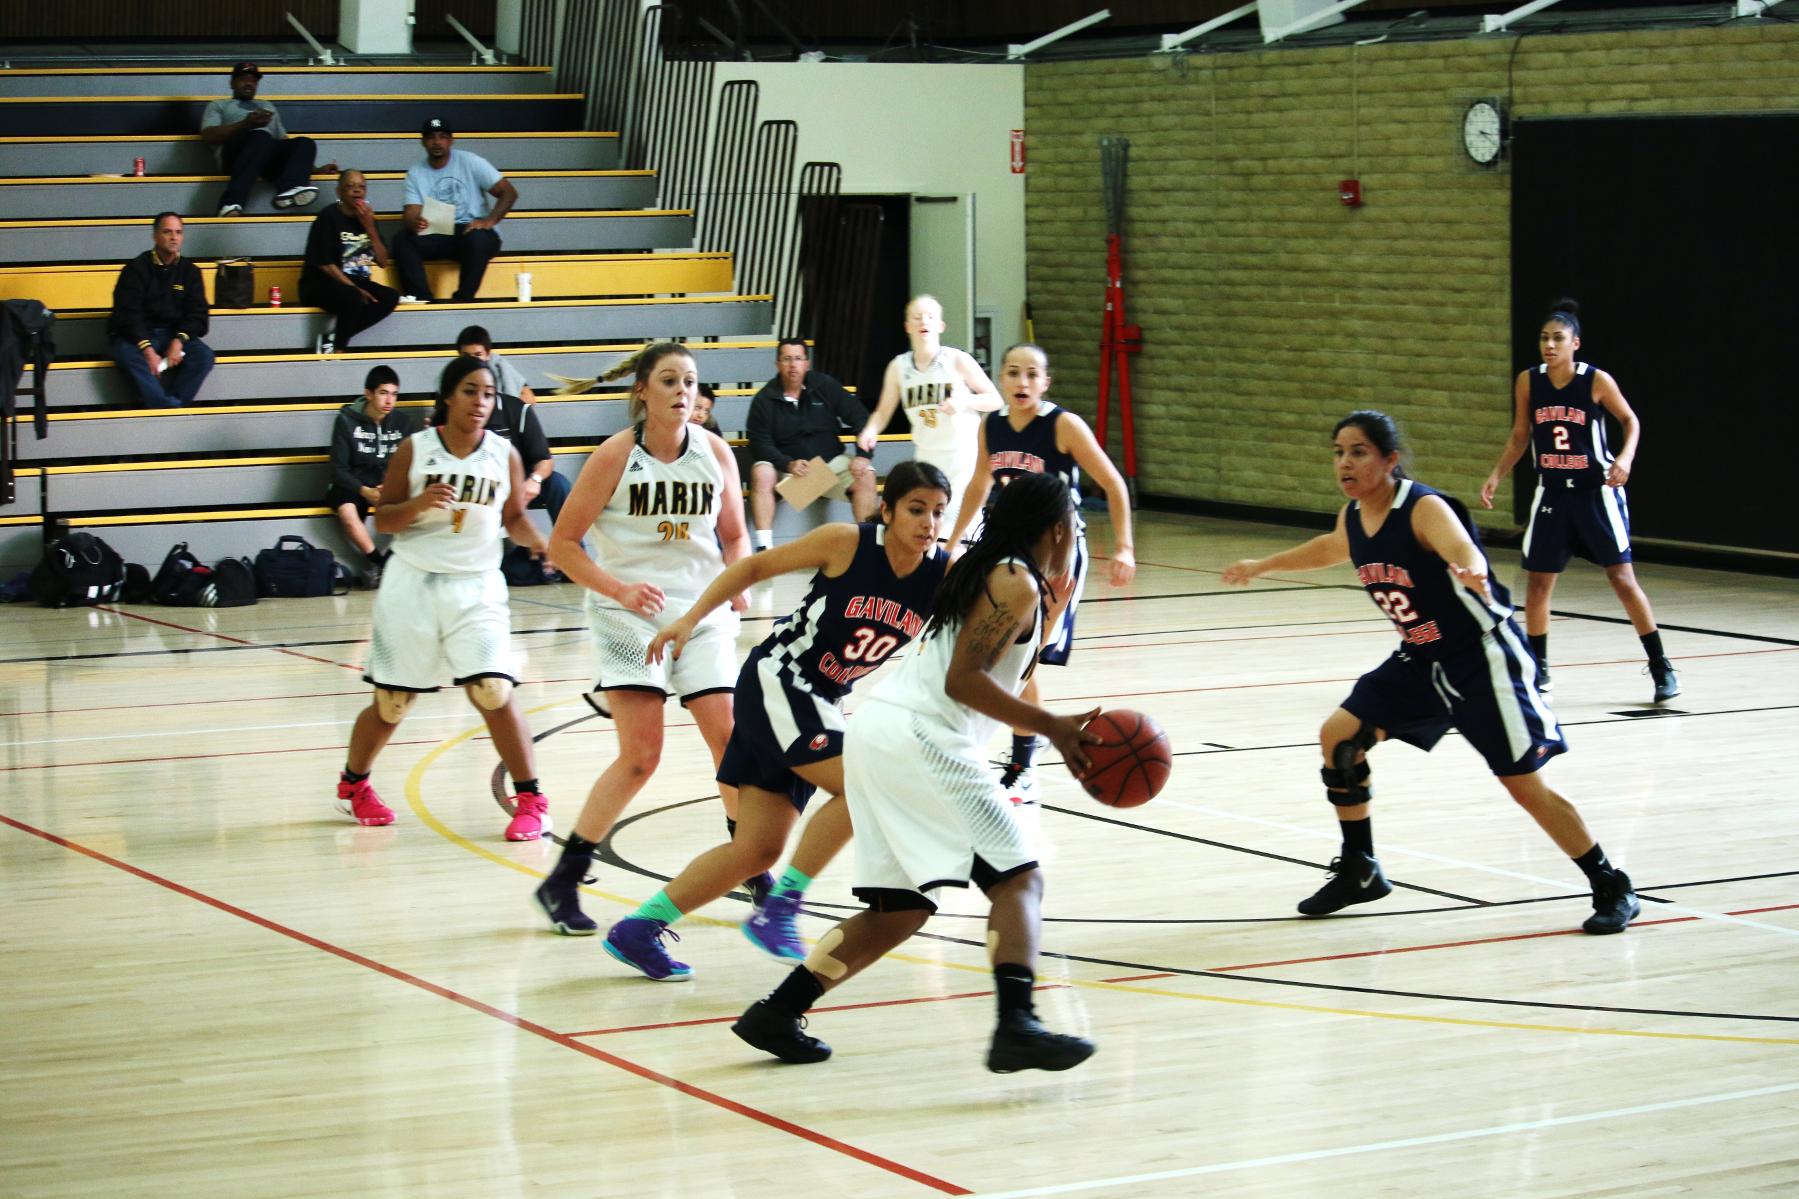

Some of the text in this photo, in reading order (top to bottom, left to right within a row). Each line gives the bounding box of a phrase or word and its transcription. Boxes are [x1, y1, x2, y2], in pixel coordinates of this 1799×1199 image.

[1535, 405, 1587, 426] GAVILAN
[1552, 425, 1571, 451] 2
[1539, 453, 1590, 470] COLLEGE
[627, 481, 714, 517] MARIN
[844, 595, 924, 641] GAVILAN
[1372, 590, 1420, 624] 22
[842, 626, 899, 663] 30
